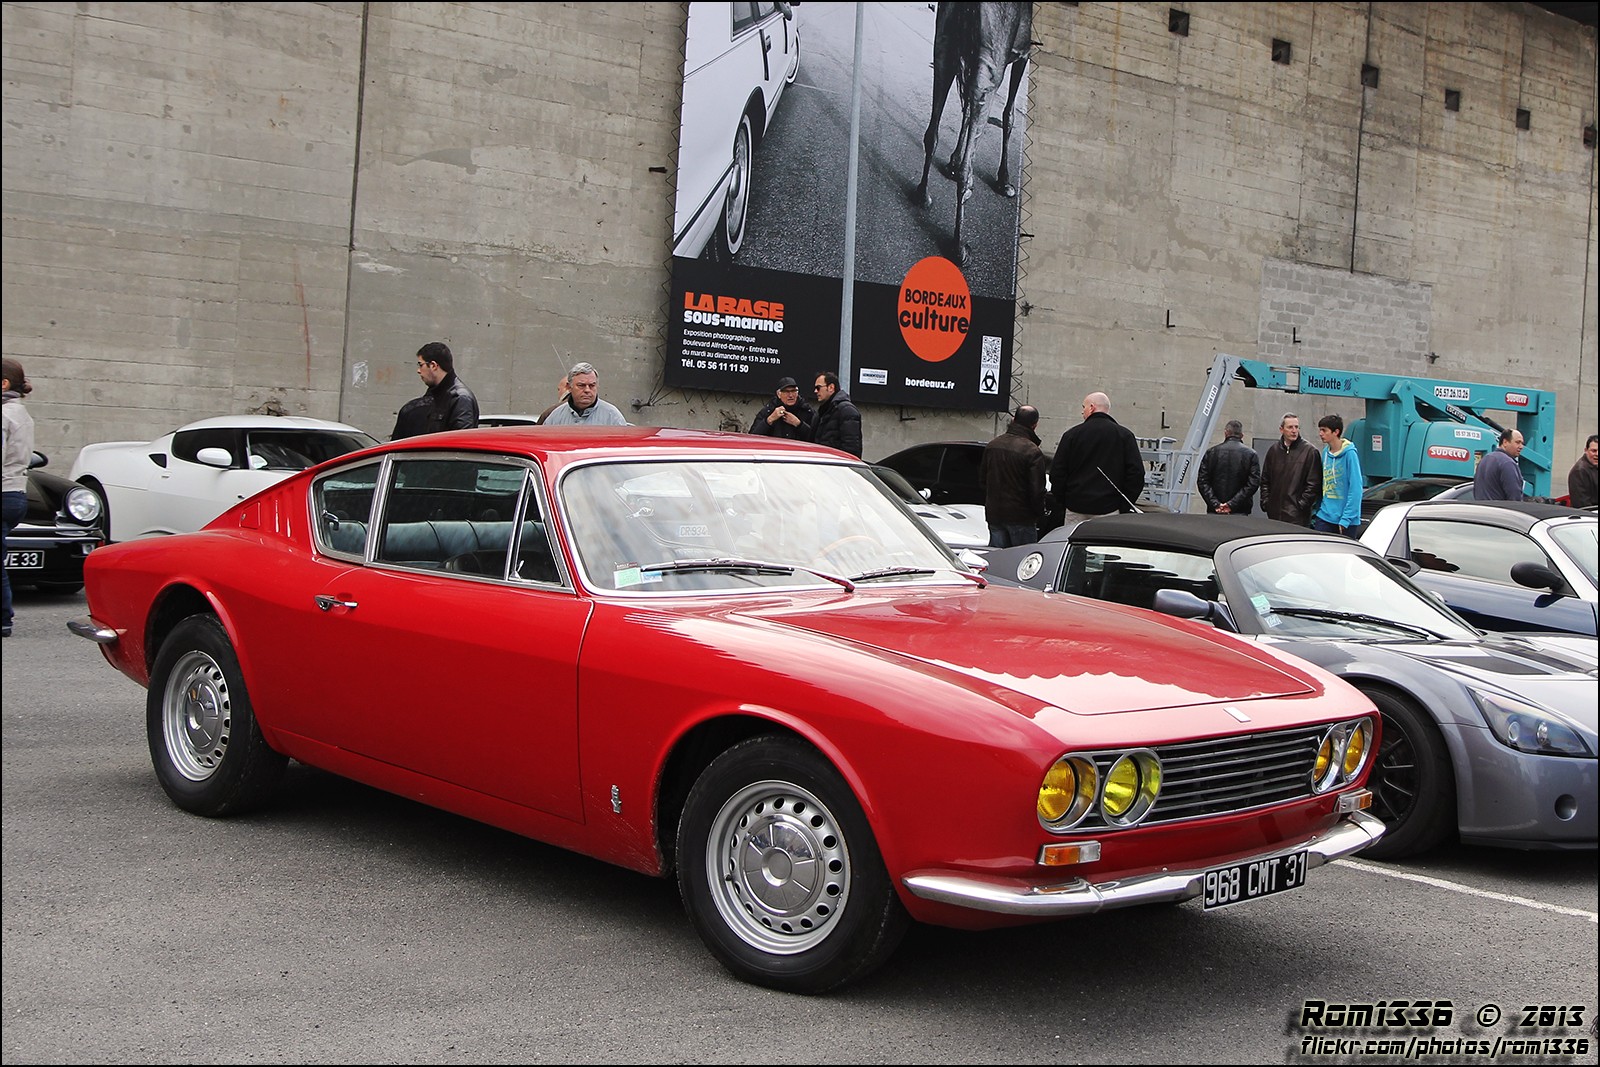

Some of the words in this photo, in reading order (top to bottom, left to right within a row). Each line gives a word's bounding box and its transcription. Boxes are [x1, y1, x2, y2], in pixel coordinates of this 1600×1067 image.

[684, 291, 715, 313] LA
[717, 296, 784, 320] BASE
[905, 288, 966, 309] BORDEAUX
[683, 310, 784, 333] sous-marine
[900, 306, 969, 334] culture
[683, 329, 712, 338] Exposition
[713, 332, 756, 343] photographique
[682, 339, 710, 348] Boulevard
[711, 342, 745, 352] Alfred-Daney
[749, 346, 766, 354] Entrée
[714, 352, 740, 361] dimanche
[681, 359, 695, 368] Tél.
[697, 360, 706, 369] 05
[707, 361, 717, 370] 56
[719, 362, 727, 371] 11
[729, 363, 738, 372] 11
[739, 364, 749, 373] 50
[905, 377, 955, 390] bordeaux.fr
[1308, 375, 1341, 390] Haulotte
[1435, 387, 1469, 399] 05.57.26.13.26
[21, 553, 38, 566] 33
[1206, 867, 1240, 906] 968
[1248, 858, 1280, 896] CMT
[1286, 852, 1306, 887] 31
